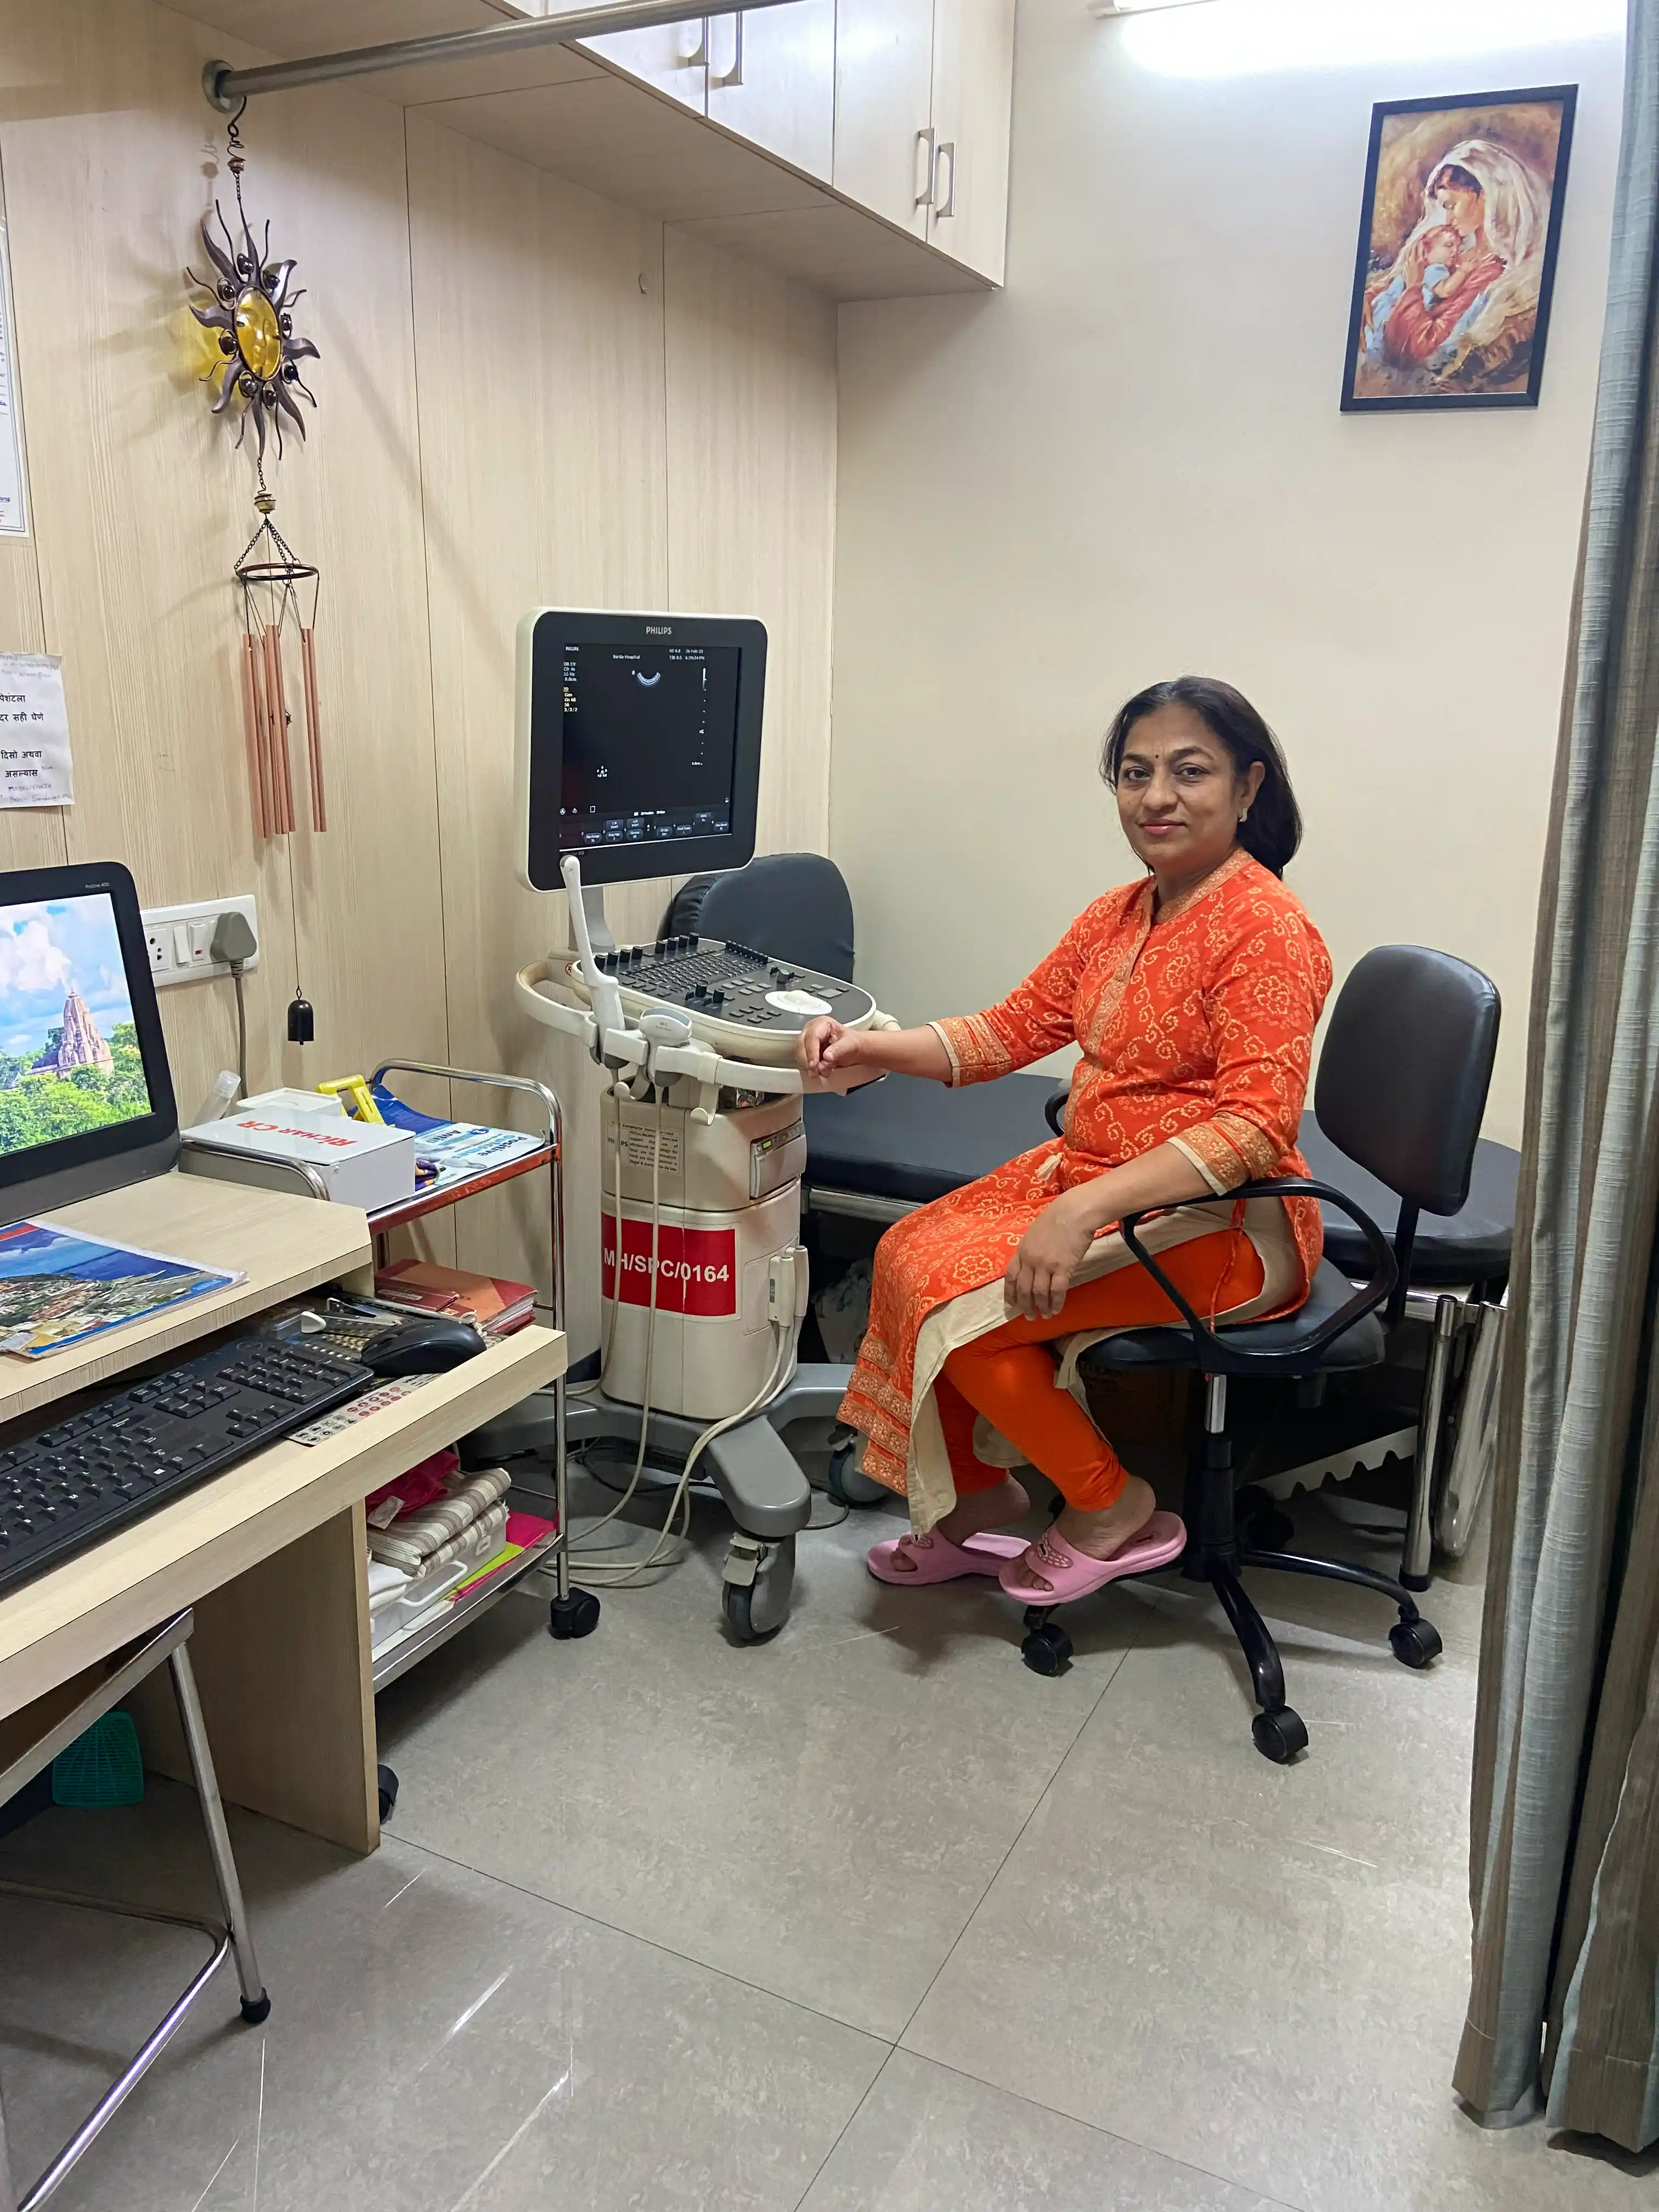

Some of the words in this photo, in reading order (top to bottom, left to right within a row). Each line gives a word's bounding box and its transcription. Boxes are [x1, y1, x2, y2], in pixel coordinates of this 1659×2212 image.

[646, 626, 672, 635] PHILIPS
[12, 711, 27, 722] सही
[5, 769, 38, 778] असल्यास
[236, 1120, 279, 1131] CR
[451, 1135, 516, 1159] Outcomes
[477, 1136, 528, 1156] Positive
